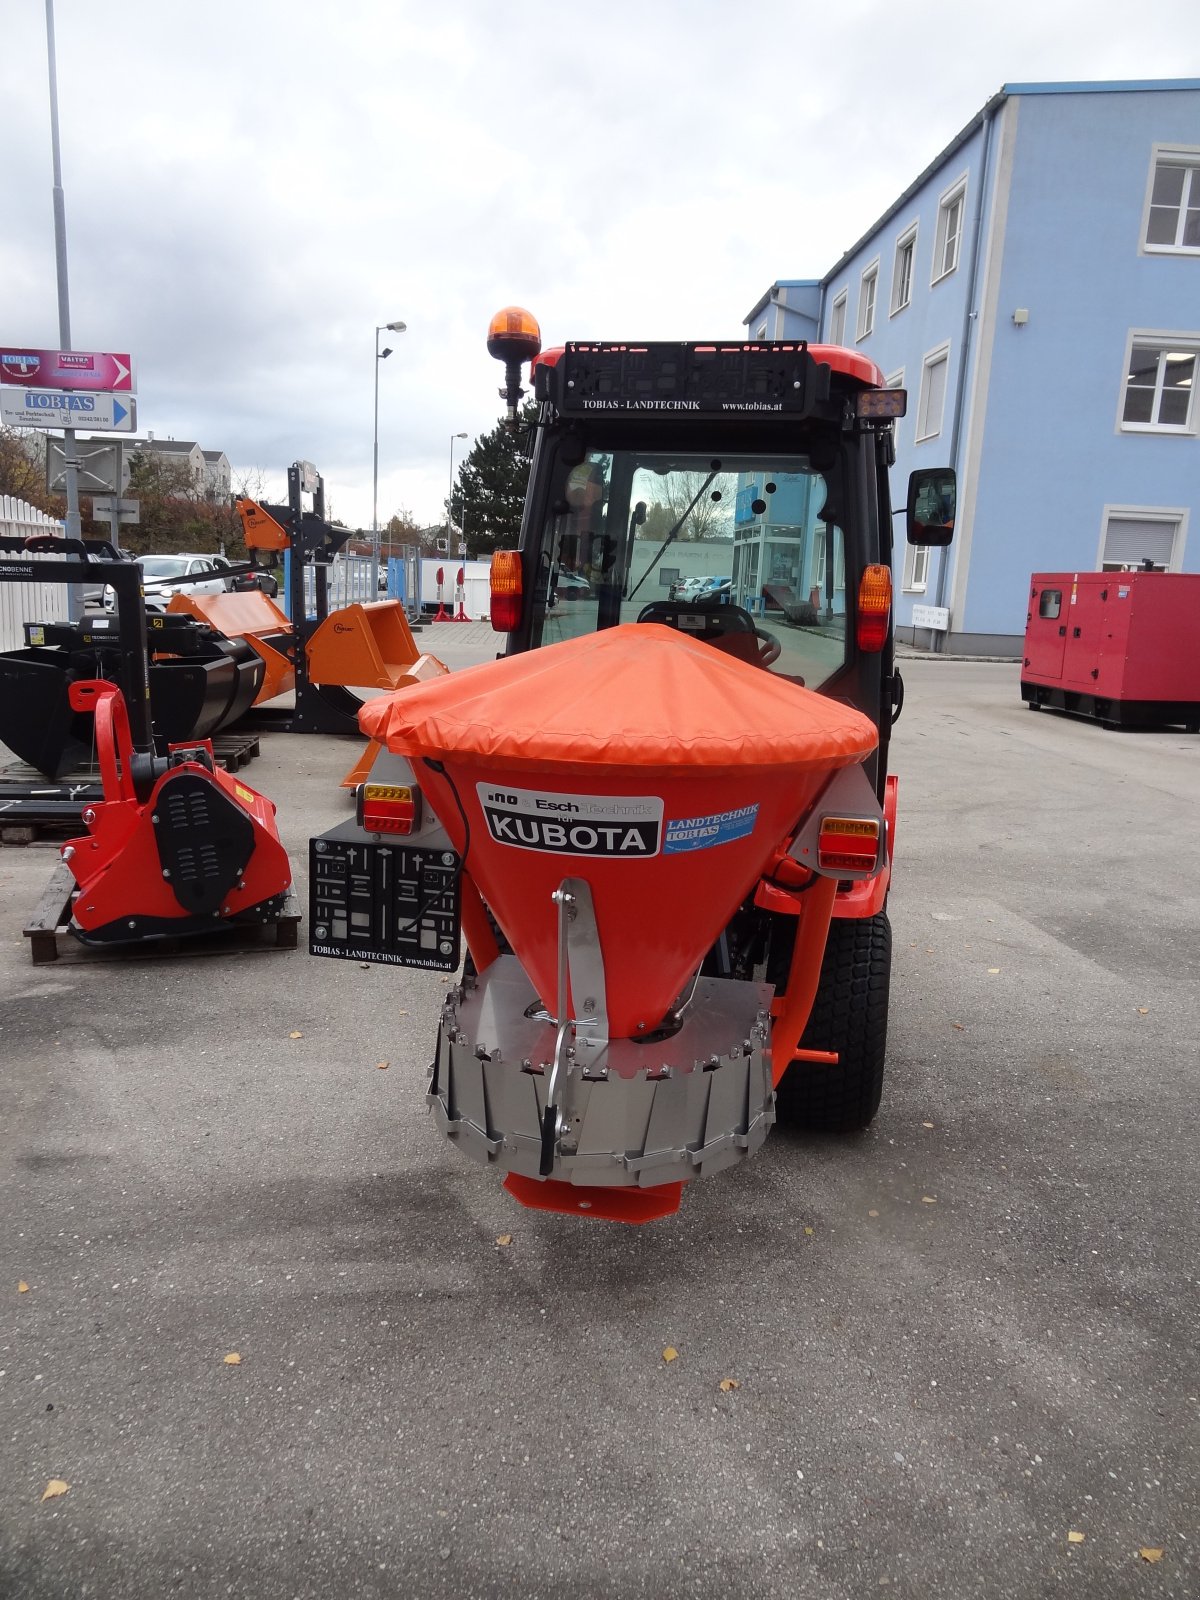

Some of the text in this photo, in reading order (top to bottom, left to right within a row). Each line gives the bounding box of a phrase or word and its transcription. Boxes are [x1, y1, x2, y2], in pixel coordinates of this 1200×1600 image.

[2, 355, 40, 365] TOBIAS
[26, 394, 94, 411] TOBIAS
[583, 400, 619, 409] TOBIAS
[626, 400, 701, 410] LANDTECHNIK
[722, 402, 783, 411] www.tobias.at
[668, 803, 760, 830] LANDTECHNIK
[491, 813, 647, 851] KUBOTA
[669, 826, 720, 841] TOBIAS
[312, 944, 341, 955] TOBIAS
[345, 950, 403, 963] LANDTECHNIK
[405, 957, 452, 969] www.tobias.at
